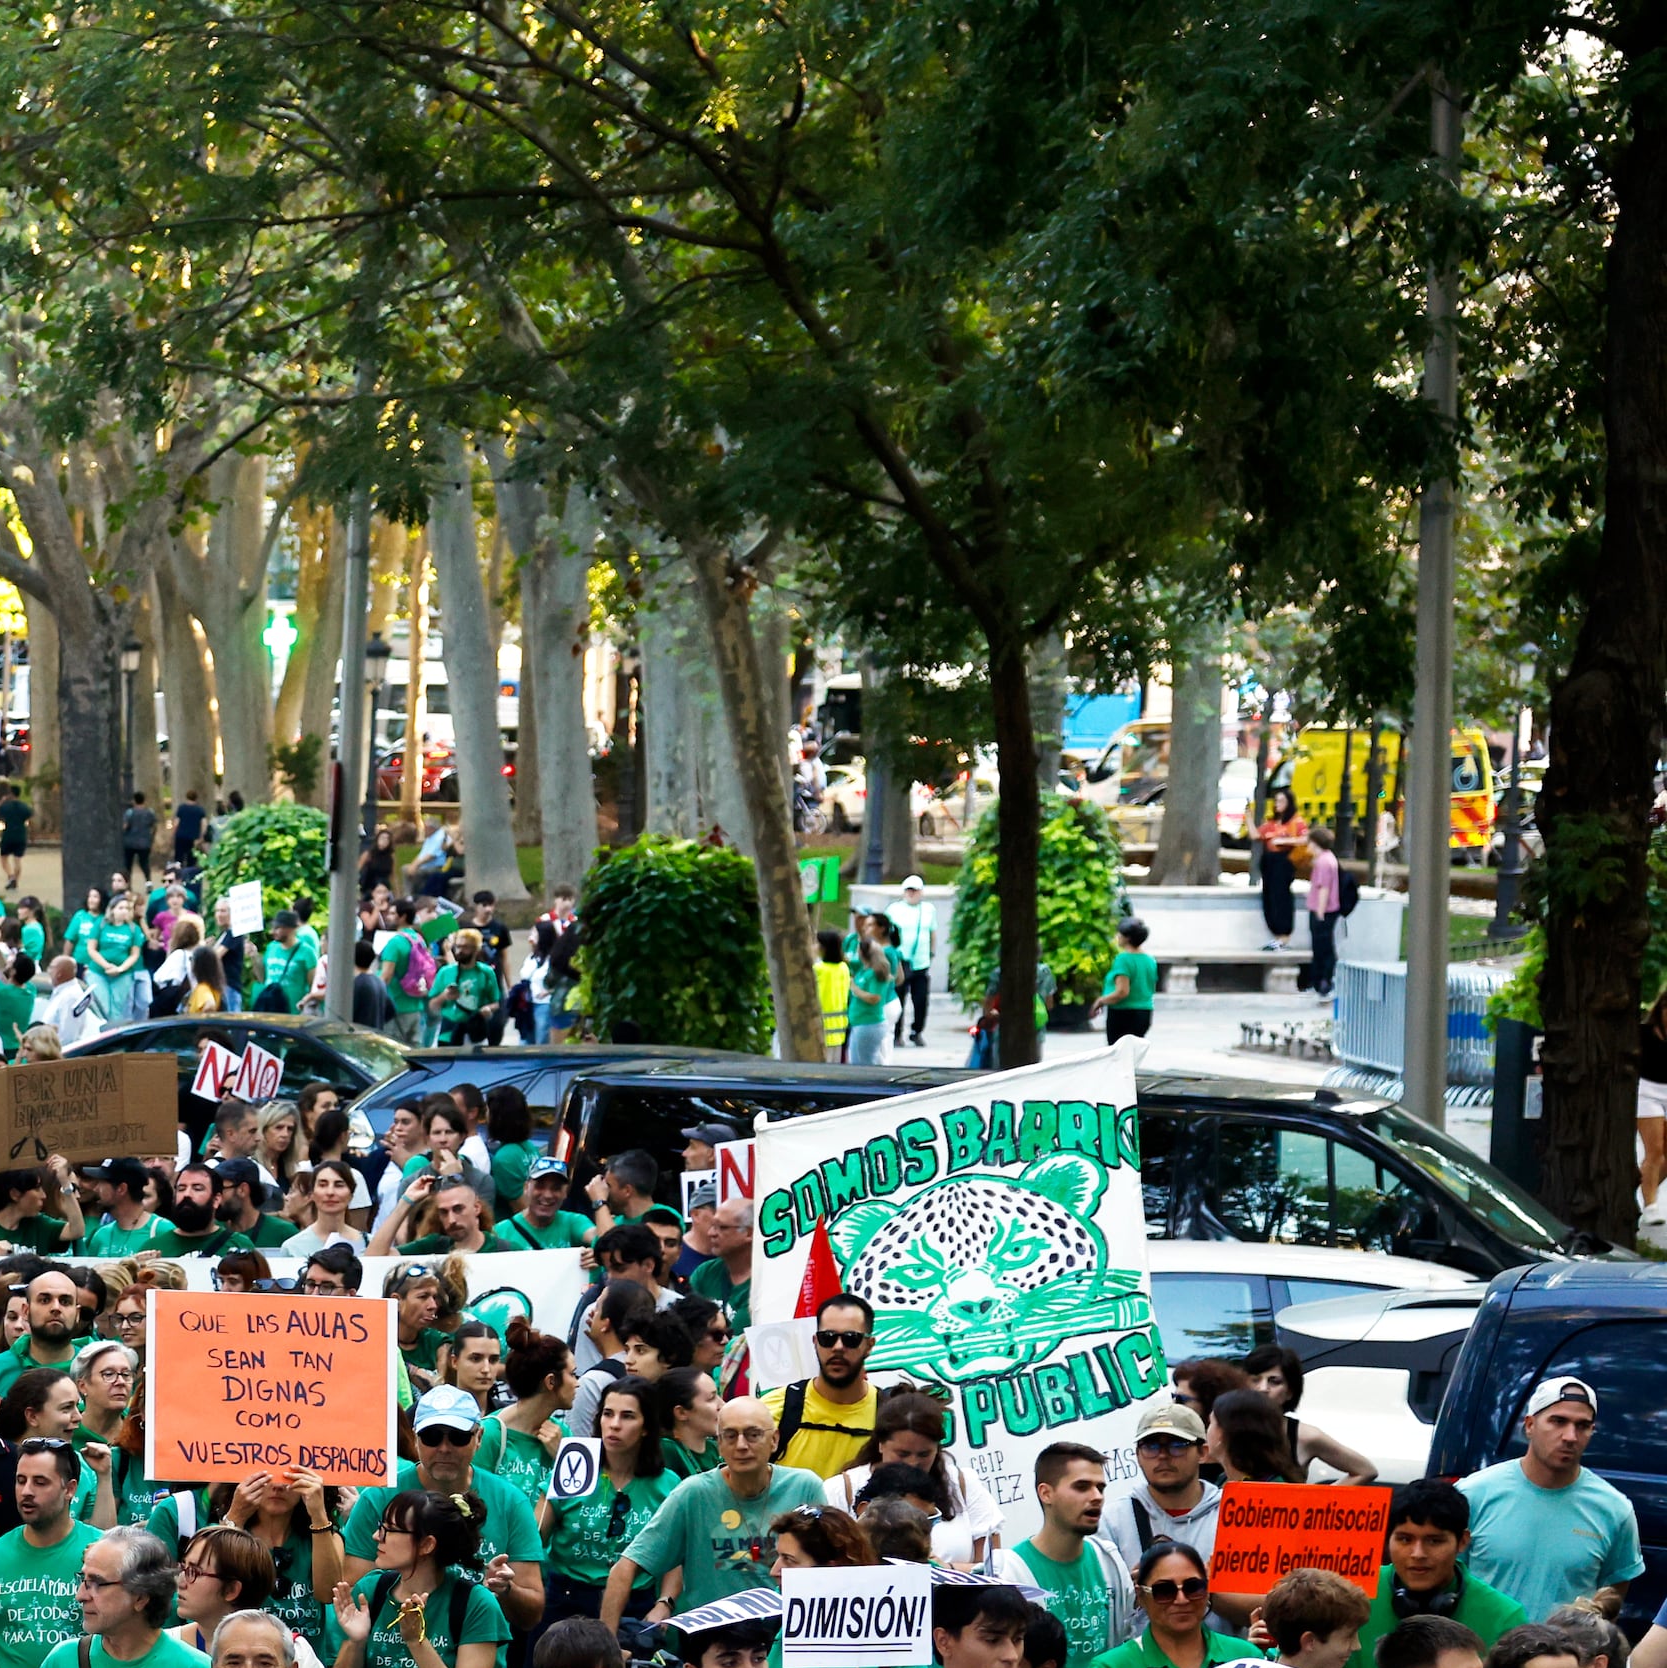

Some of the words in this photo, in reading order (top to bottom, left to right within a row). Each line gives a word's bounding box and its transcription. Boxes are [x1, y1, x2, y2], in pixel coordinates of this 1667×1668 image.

[759, 1117, 939, 1258] SOMOS
[179, 1311, 227, 1336] QUE
[247, 1312, 279, 1336] LAS
[286, 1310, 369, 1344] AULAS
[207, 1348, 265, 1370] SEAN
[290, 1349, 334, 1373] TAN
[222, 1376, 326, 1407] DIGNAS
[236, 1409, 302, 1430] COMO
[178, 1439, 292, 1467] VUESTROS
[299, 1442, 388, 1479] DESPACHOS
[1222, 1502, 1300, 1532] Gobierno
[1302, 1501, 1388, 1533] antisocial
[1212, 1545, 1271, 1578] pierde
[1274, 1546, 1377, 1577] legitimidad.
[785, 1586, 928, 1639] DIMISIÓN!
